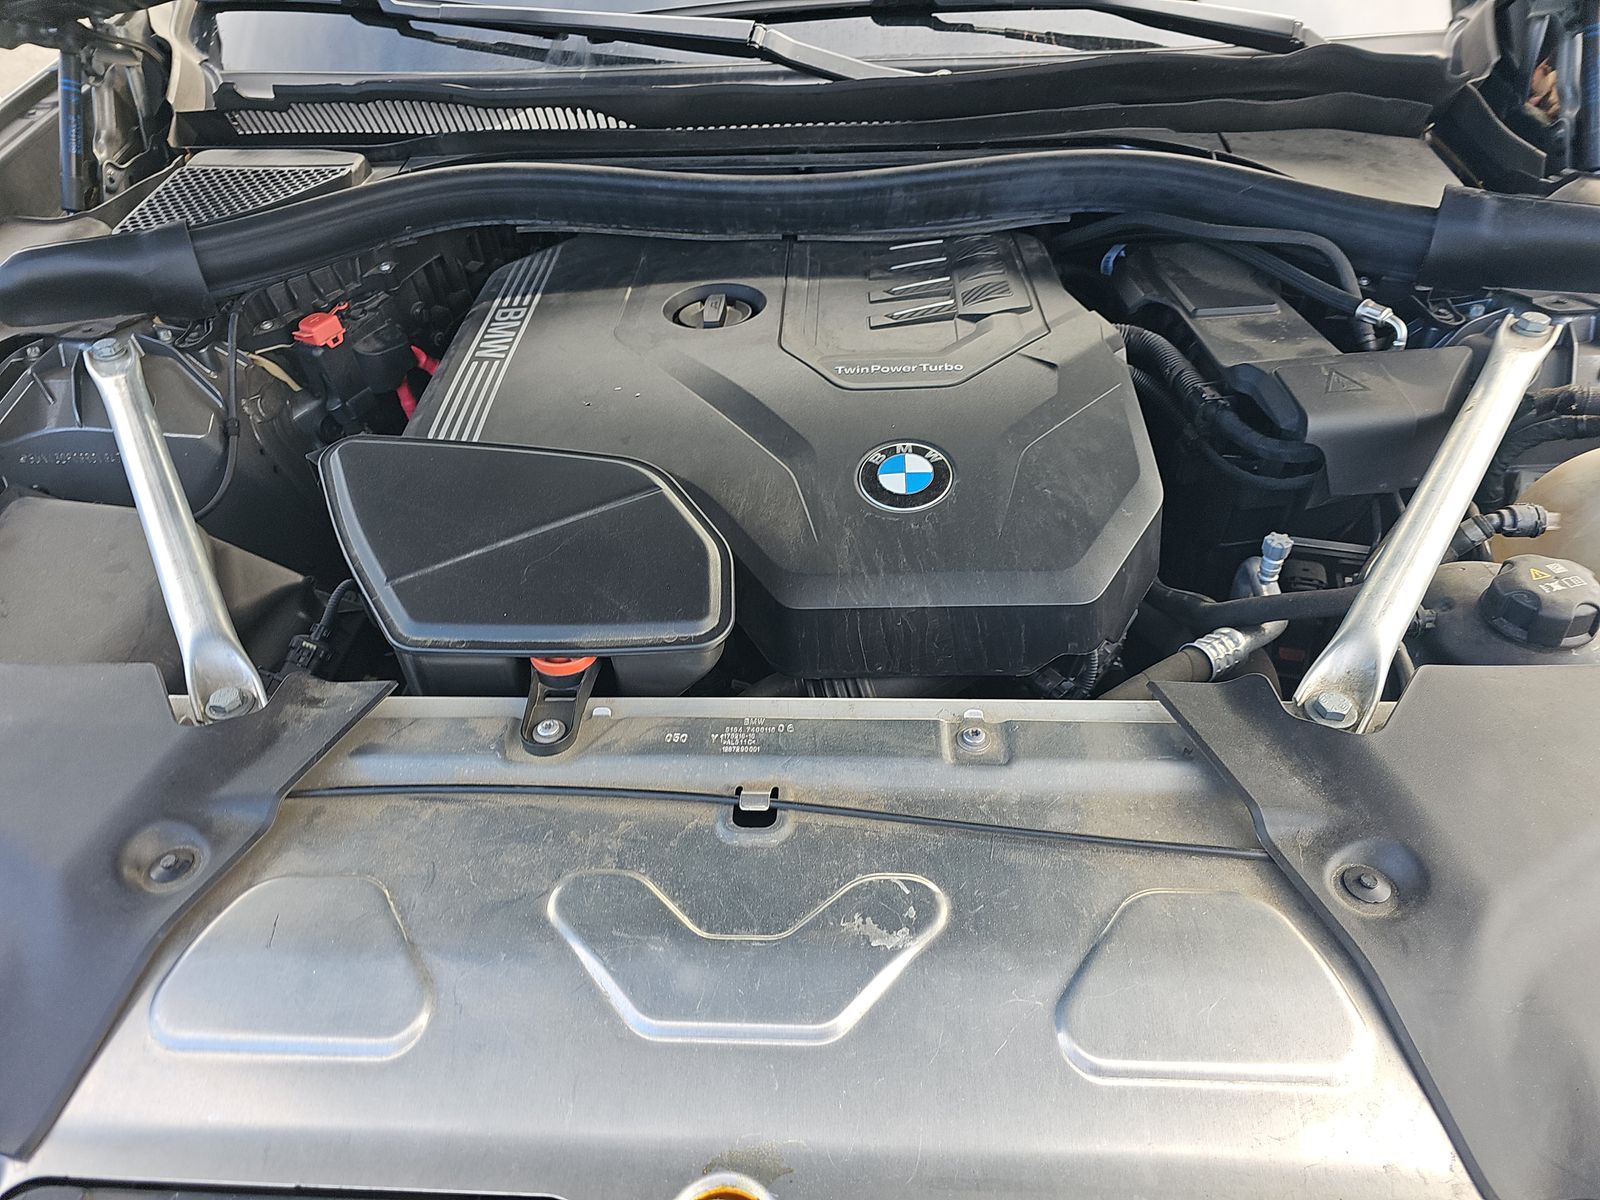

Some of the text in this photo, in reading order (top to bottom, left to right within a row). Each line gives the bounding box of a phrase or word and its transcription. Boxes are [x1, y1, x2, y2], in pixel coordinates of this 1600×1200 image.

[475, 307, 528, 359] BMW
[918, 362, 964, 372] Turbo
[868, 444, 943, 466] BMW
[744, 718, 765, 726] BMW
